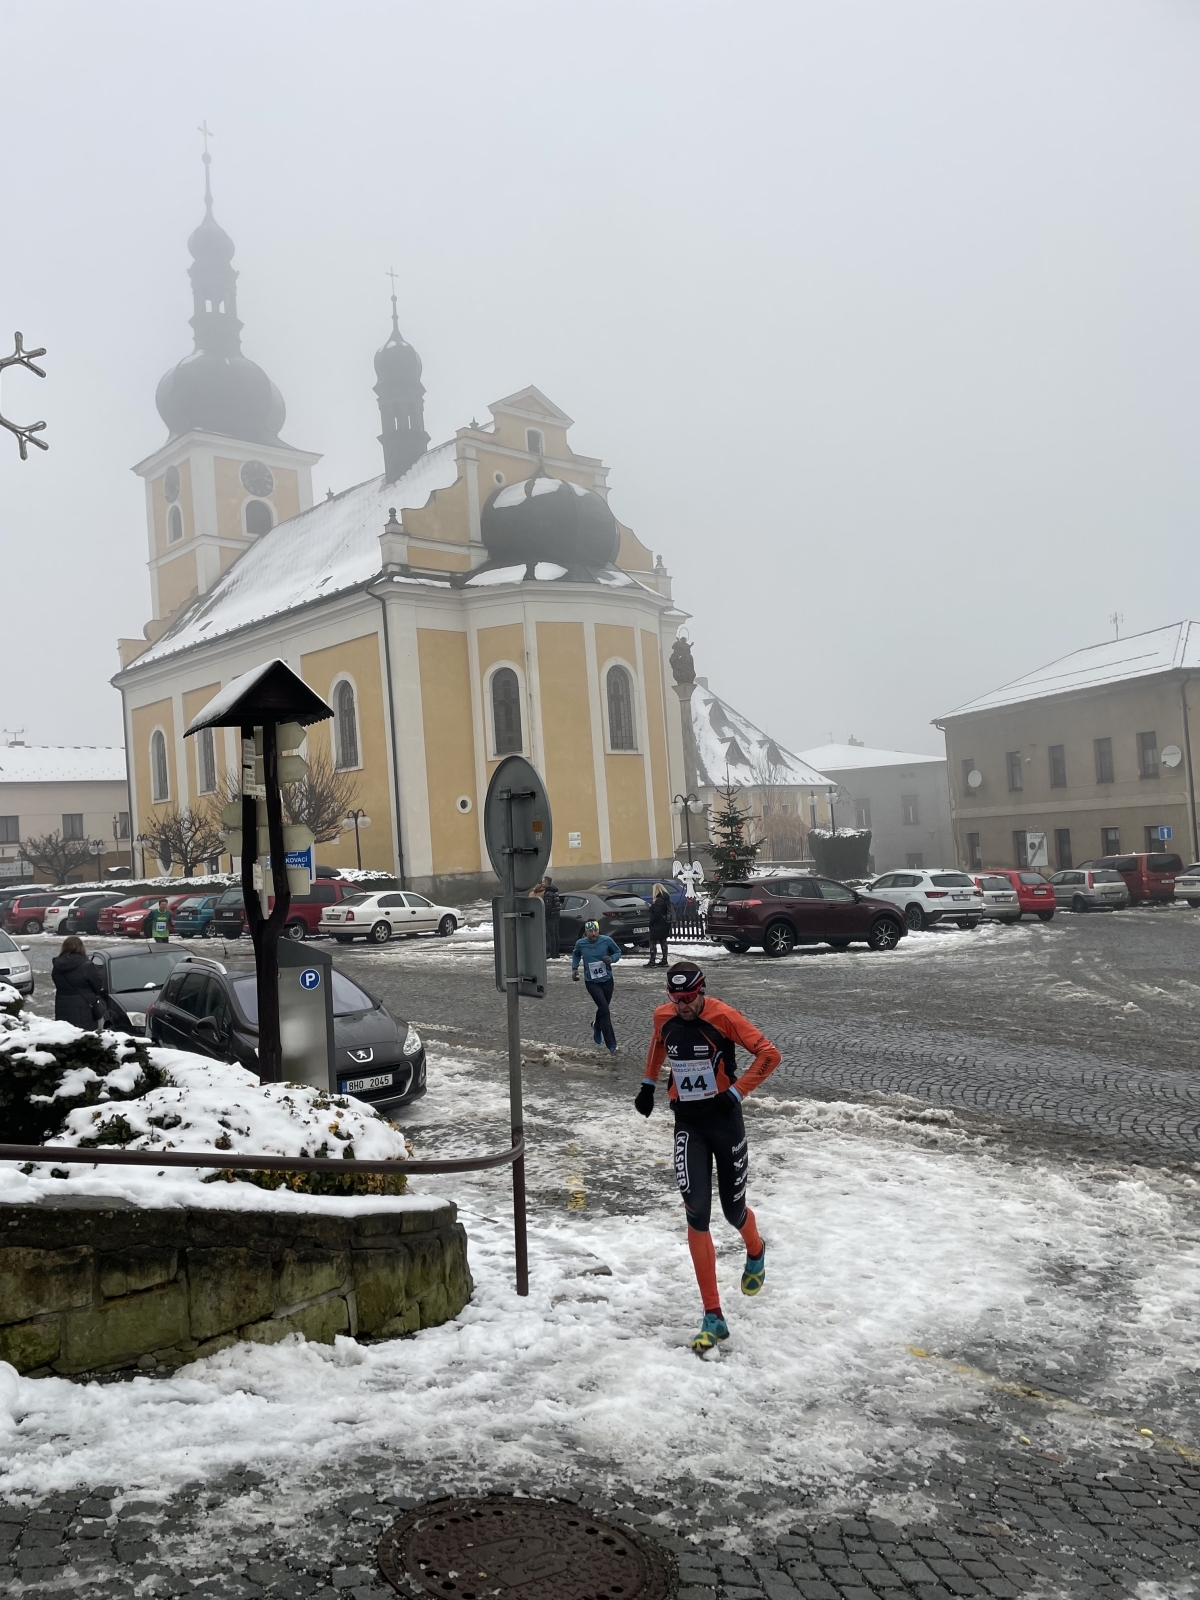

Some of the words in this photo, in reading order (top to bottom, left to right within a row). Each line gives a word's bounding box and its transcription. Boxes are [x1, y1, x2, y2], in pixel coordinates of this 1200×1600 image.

[285, 856, 308, 864] KOVACÍ
[593, 967, 604, 975] 46
[305, 973, 316, 986] P
[369, 1075, 390, 1087] 2045
[680, 1075, 708, 1092] 44
[675, 1135, 687, 1187] KASPER
